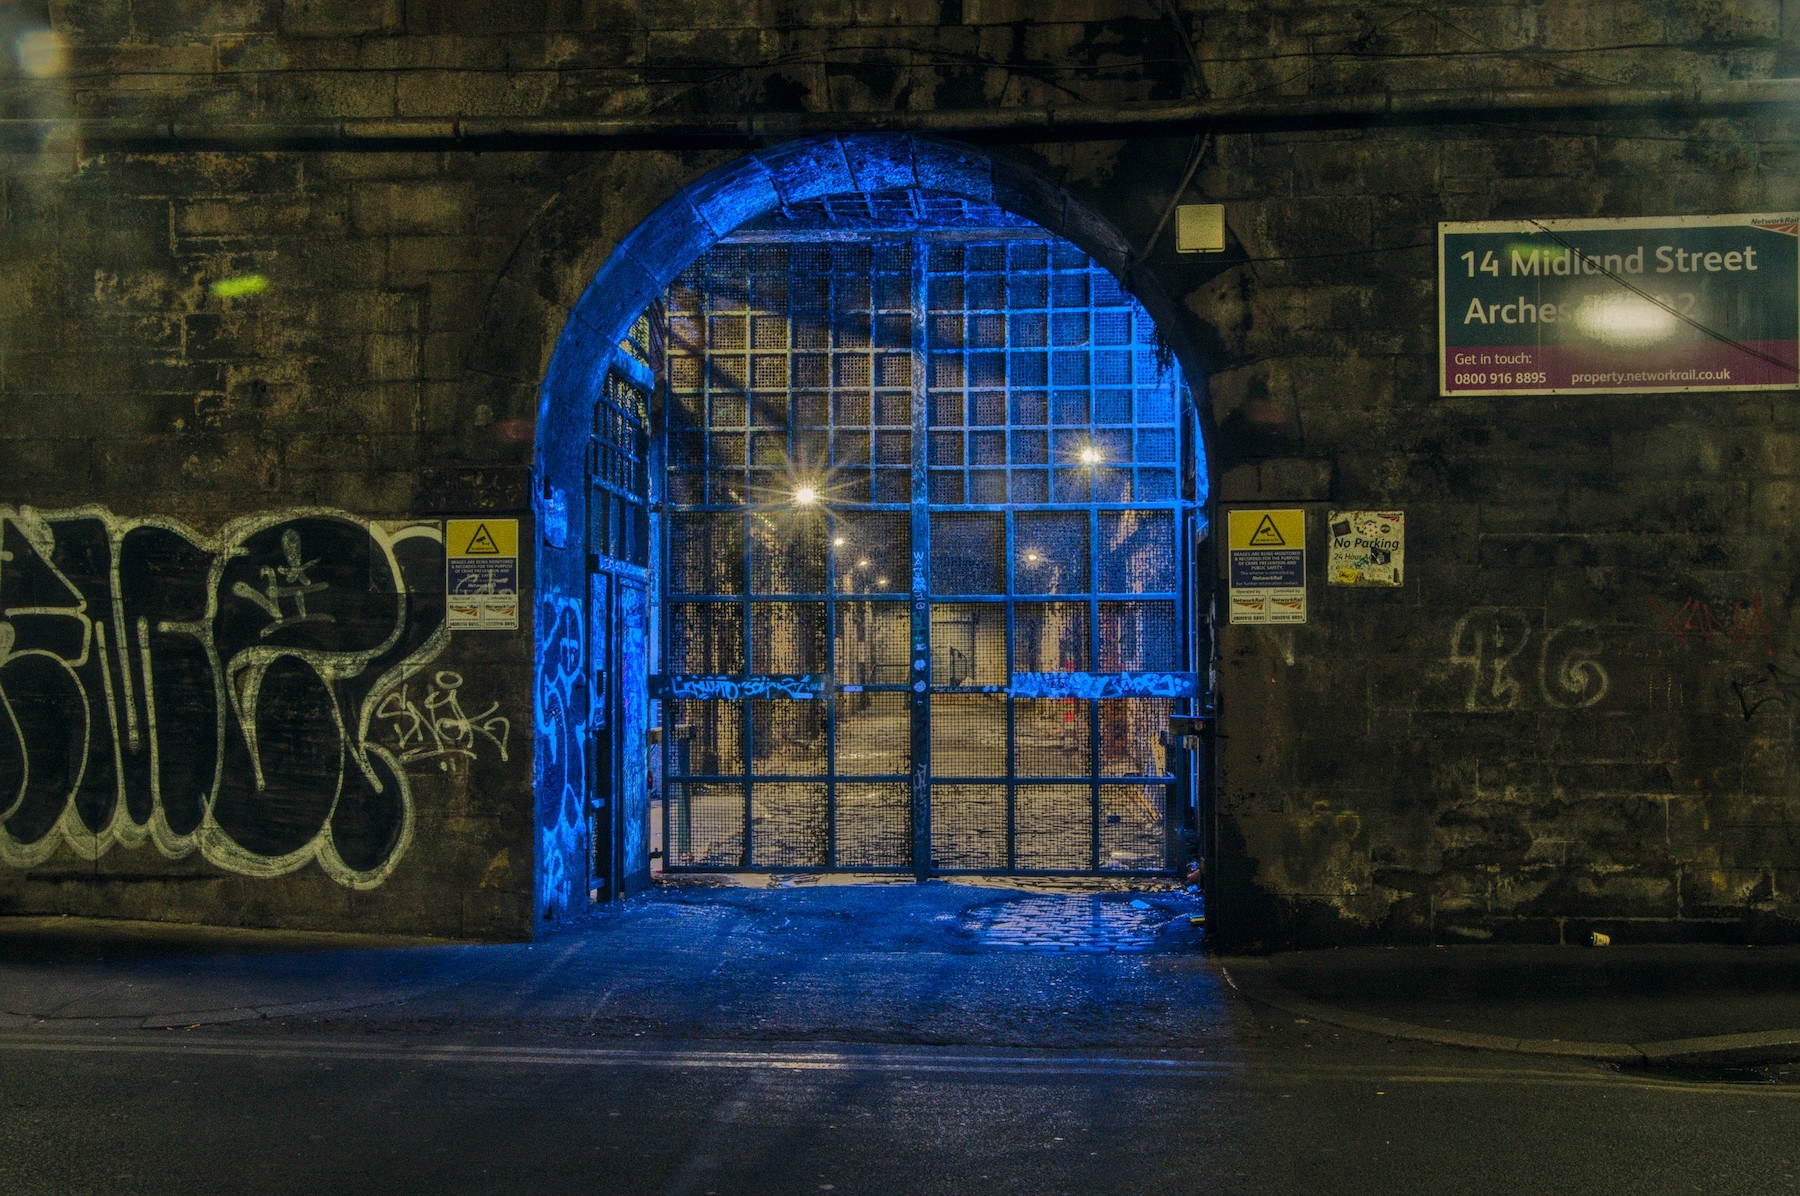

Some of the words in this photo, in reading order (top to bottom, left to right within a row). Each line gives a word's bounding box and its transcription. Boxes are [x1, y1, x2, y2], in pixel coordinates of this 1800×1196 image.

[1751, 217, 1799, 225] NetworkRail
[1461, 250, 1499, 278] 14
[1511, 246, 1644, 277] Midland
[1655, 245, 1758, 274] Street
[1464, 296, 1573, 325] Arches
[1455, 353, 1477, 365] Get
[1480, 353, 1491, 364] in
[1495, 352, 1532, 364] touch:
[1455, 373, 1486, 385] 0800
[1490, 373, 1512, 384] 916
[1515, 372, 1547, 384] 8895
[1571, 368, 1730, 386] property.networkrail.co.uk
[1333, 537, 1351, 548] No
[1354, 537, 1399, 551] Parking
